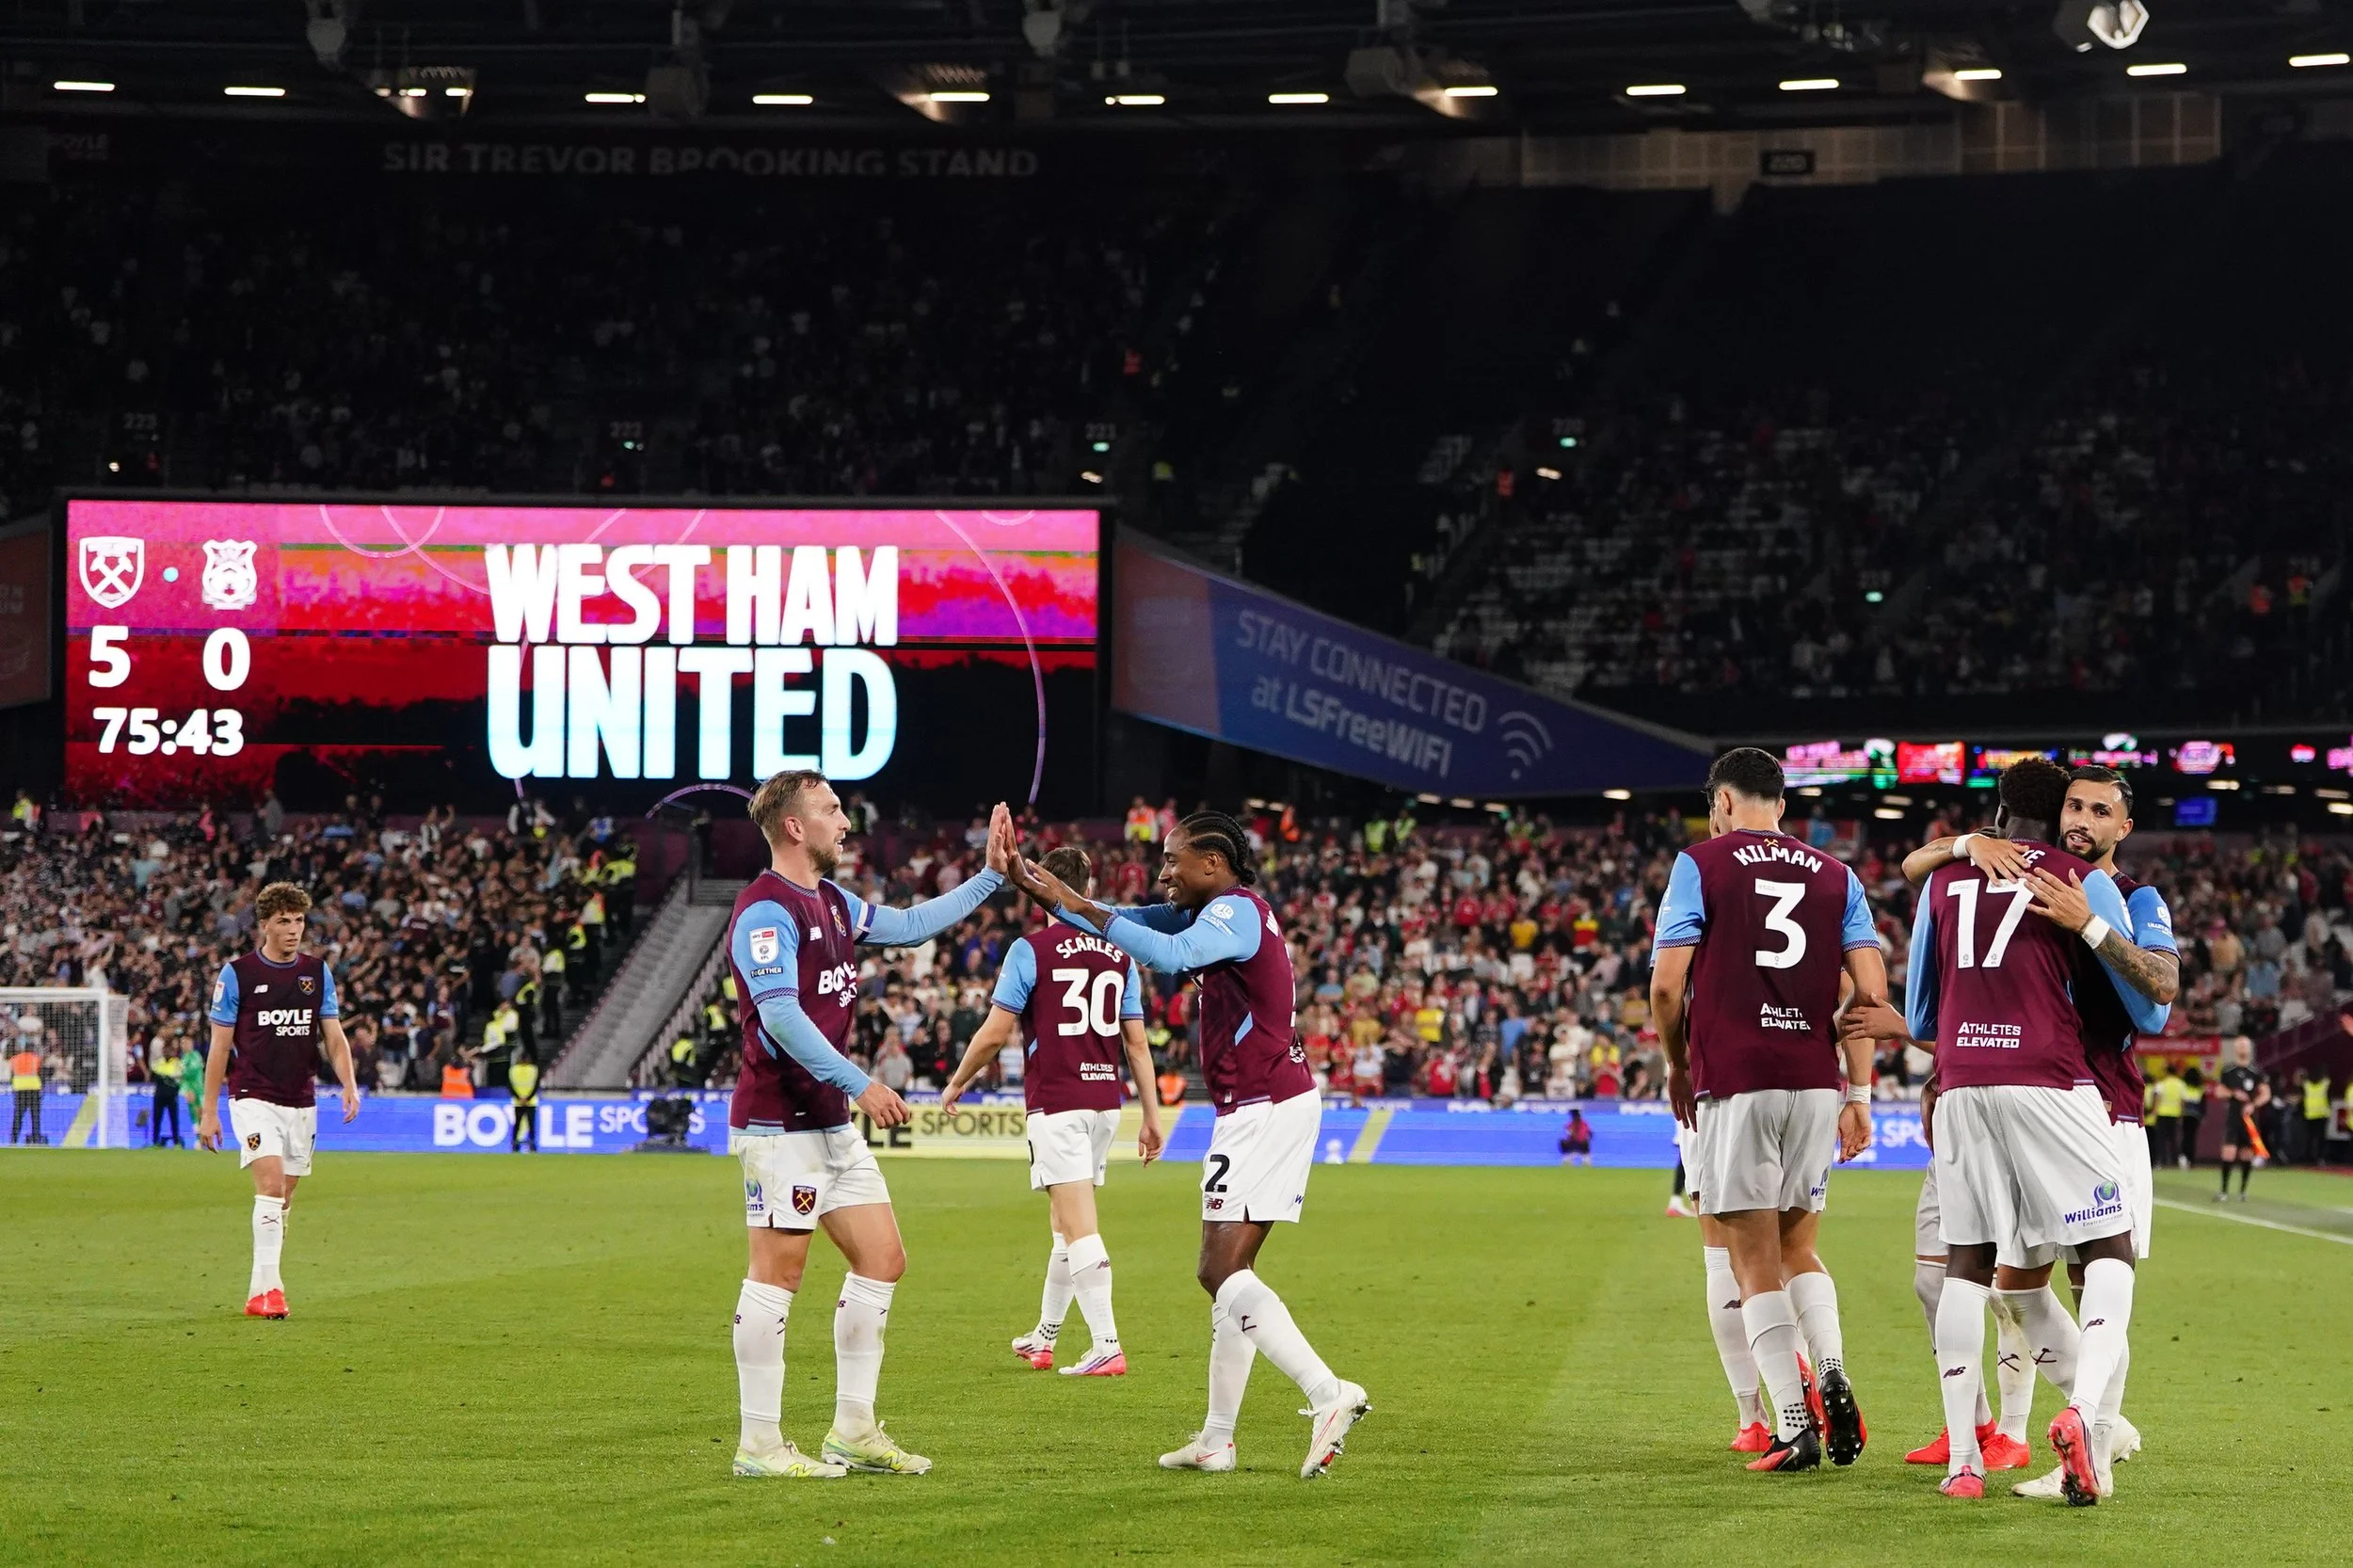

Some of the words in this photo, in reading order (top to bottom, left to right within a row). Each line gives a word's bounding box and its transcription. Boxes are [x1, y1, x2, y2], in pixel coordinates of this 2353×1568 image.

[382, 142, 450, 172] SIR
[461, 143, 635, 175] TREVOR
[897, 147, 1035, 177] STAND
[484, 543, 711, 645] WEST
[726, 545, 899, 646] HAM
[88, 625, 131, 688] 5
[202, 627, 251, 691] 0
[1235, 609, 1310, 662] STAY
[1310, 638, 1488, 735] CONNECTED
[488, 646, 898, 781] UNITED
[1251, 675, 1285, 714] at
[93, 707, 245, 757] 75:43
[1733, 844, 1823, 873] KILMAN
[1754, 877, 1807, 969] 3
[1946, 877, 2041, 969] 17
[1055, 936, 1123, 964] SCARLES
[258, 1009, 312, 1026] BOYLE
[1051, 968, 1125, 1037] 30
[276, 1026, 310, 1036] SPORTS
[1956, 1036, 2020, 1048] ELEVATED
[1958, 1021, 2022, 1035] ATHLETES
[433, 1103, 594, 1147] BOLE
[921, 1111, 1025, 1137] SPORTS
[1205, 1154, 1230, 1192] 2
[2064, 1203, 2122, 1224] Williams
